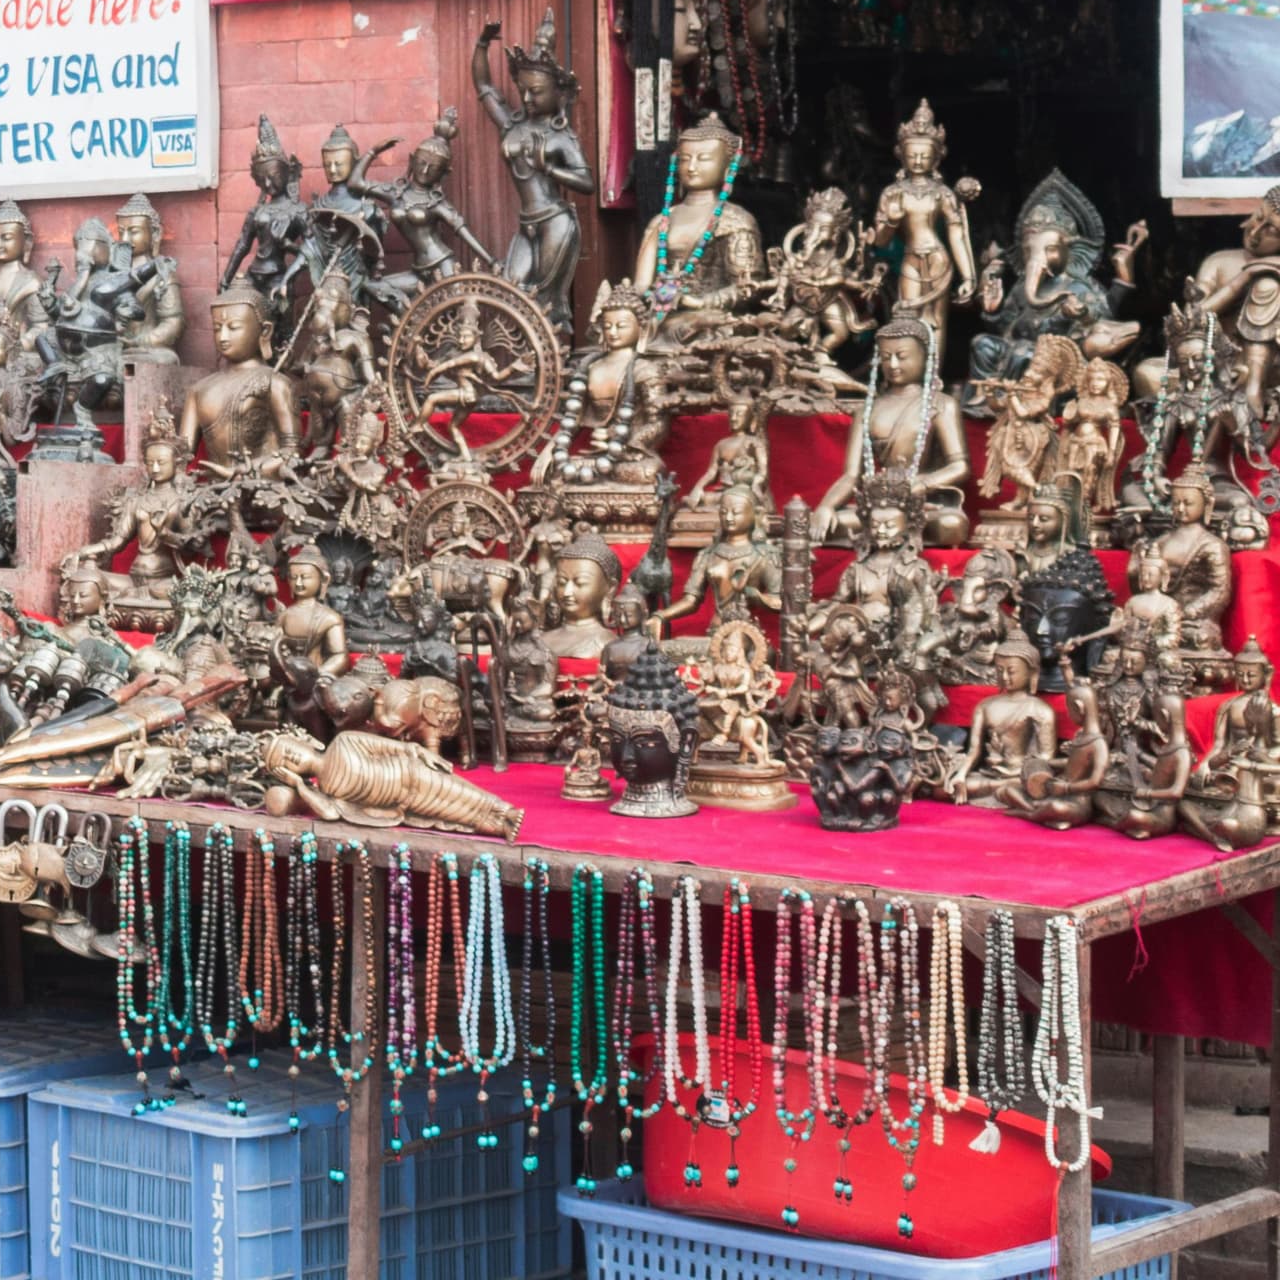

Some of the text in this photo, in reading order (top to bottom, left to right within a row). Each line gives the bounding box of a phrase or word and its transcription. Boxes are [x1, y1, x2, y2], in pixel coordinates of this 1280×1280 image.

[110, 41, 181, 89] and
[69, 117, 150, 160] CARD
[157, 132, 194, 153] VISA
[211, 1162, 225, 1280] FC/KTM
